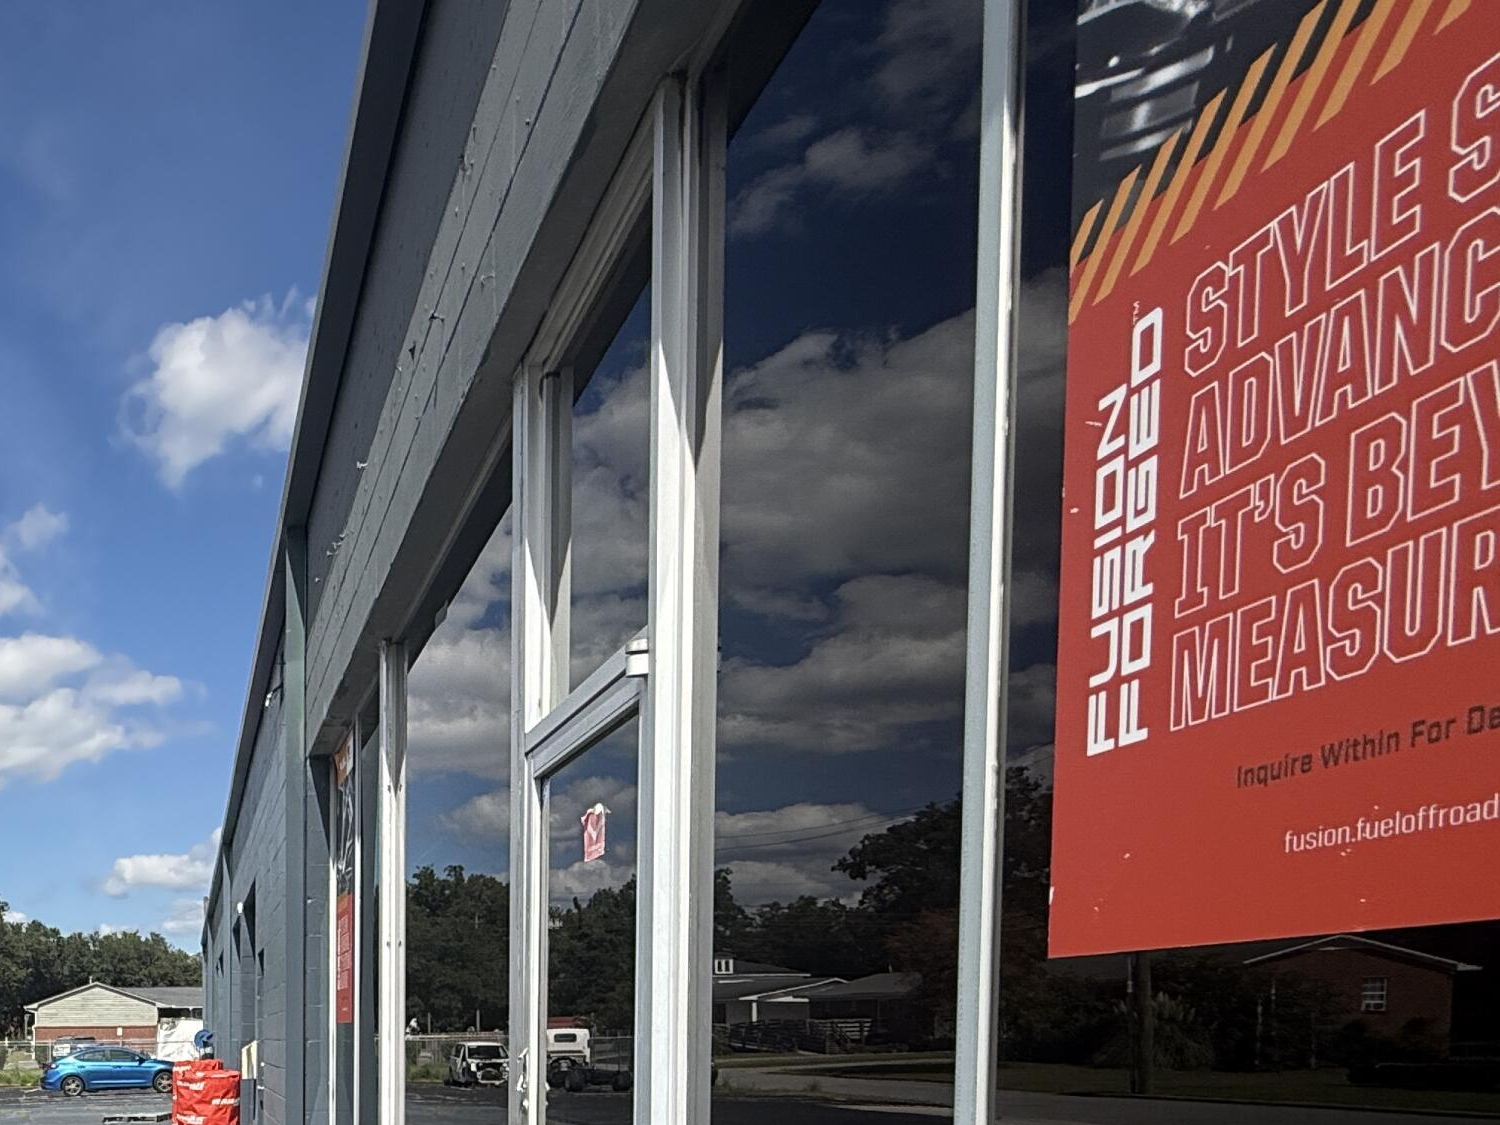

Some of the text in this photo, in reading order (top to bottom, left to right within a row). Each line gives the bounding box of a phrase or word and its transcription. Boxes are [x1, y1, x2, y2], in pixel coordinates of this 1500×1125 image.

[1179, 206, 1500, 499] ADVANC
[1184, 109, 1426, 378] STYLE
[1086, 384, 1128, 757] FUSION
[1118, 306, 1164, 748] FORGED
[1169, 504, 1500, 732] MEASUR
[1174, 452, 1325, 620] IT'S
[1236, 752, 1313, 789] Inquire
[1320, 729, 1400, 769] Within
[1410, 718, 1457, 748] For
[1284, 793, 1500, 853] fusion.fueloffroad
